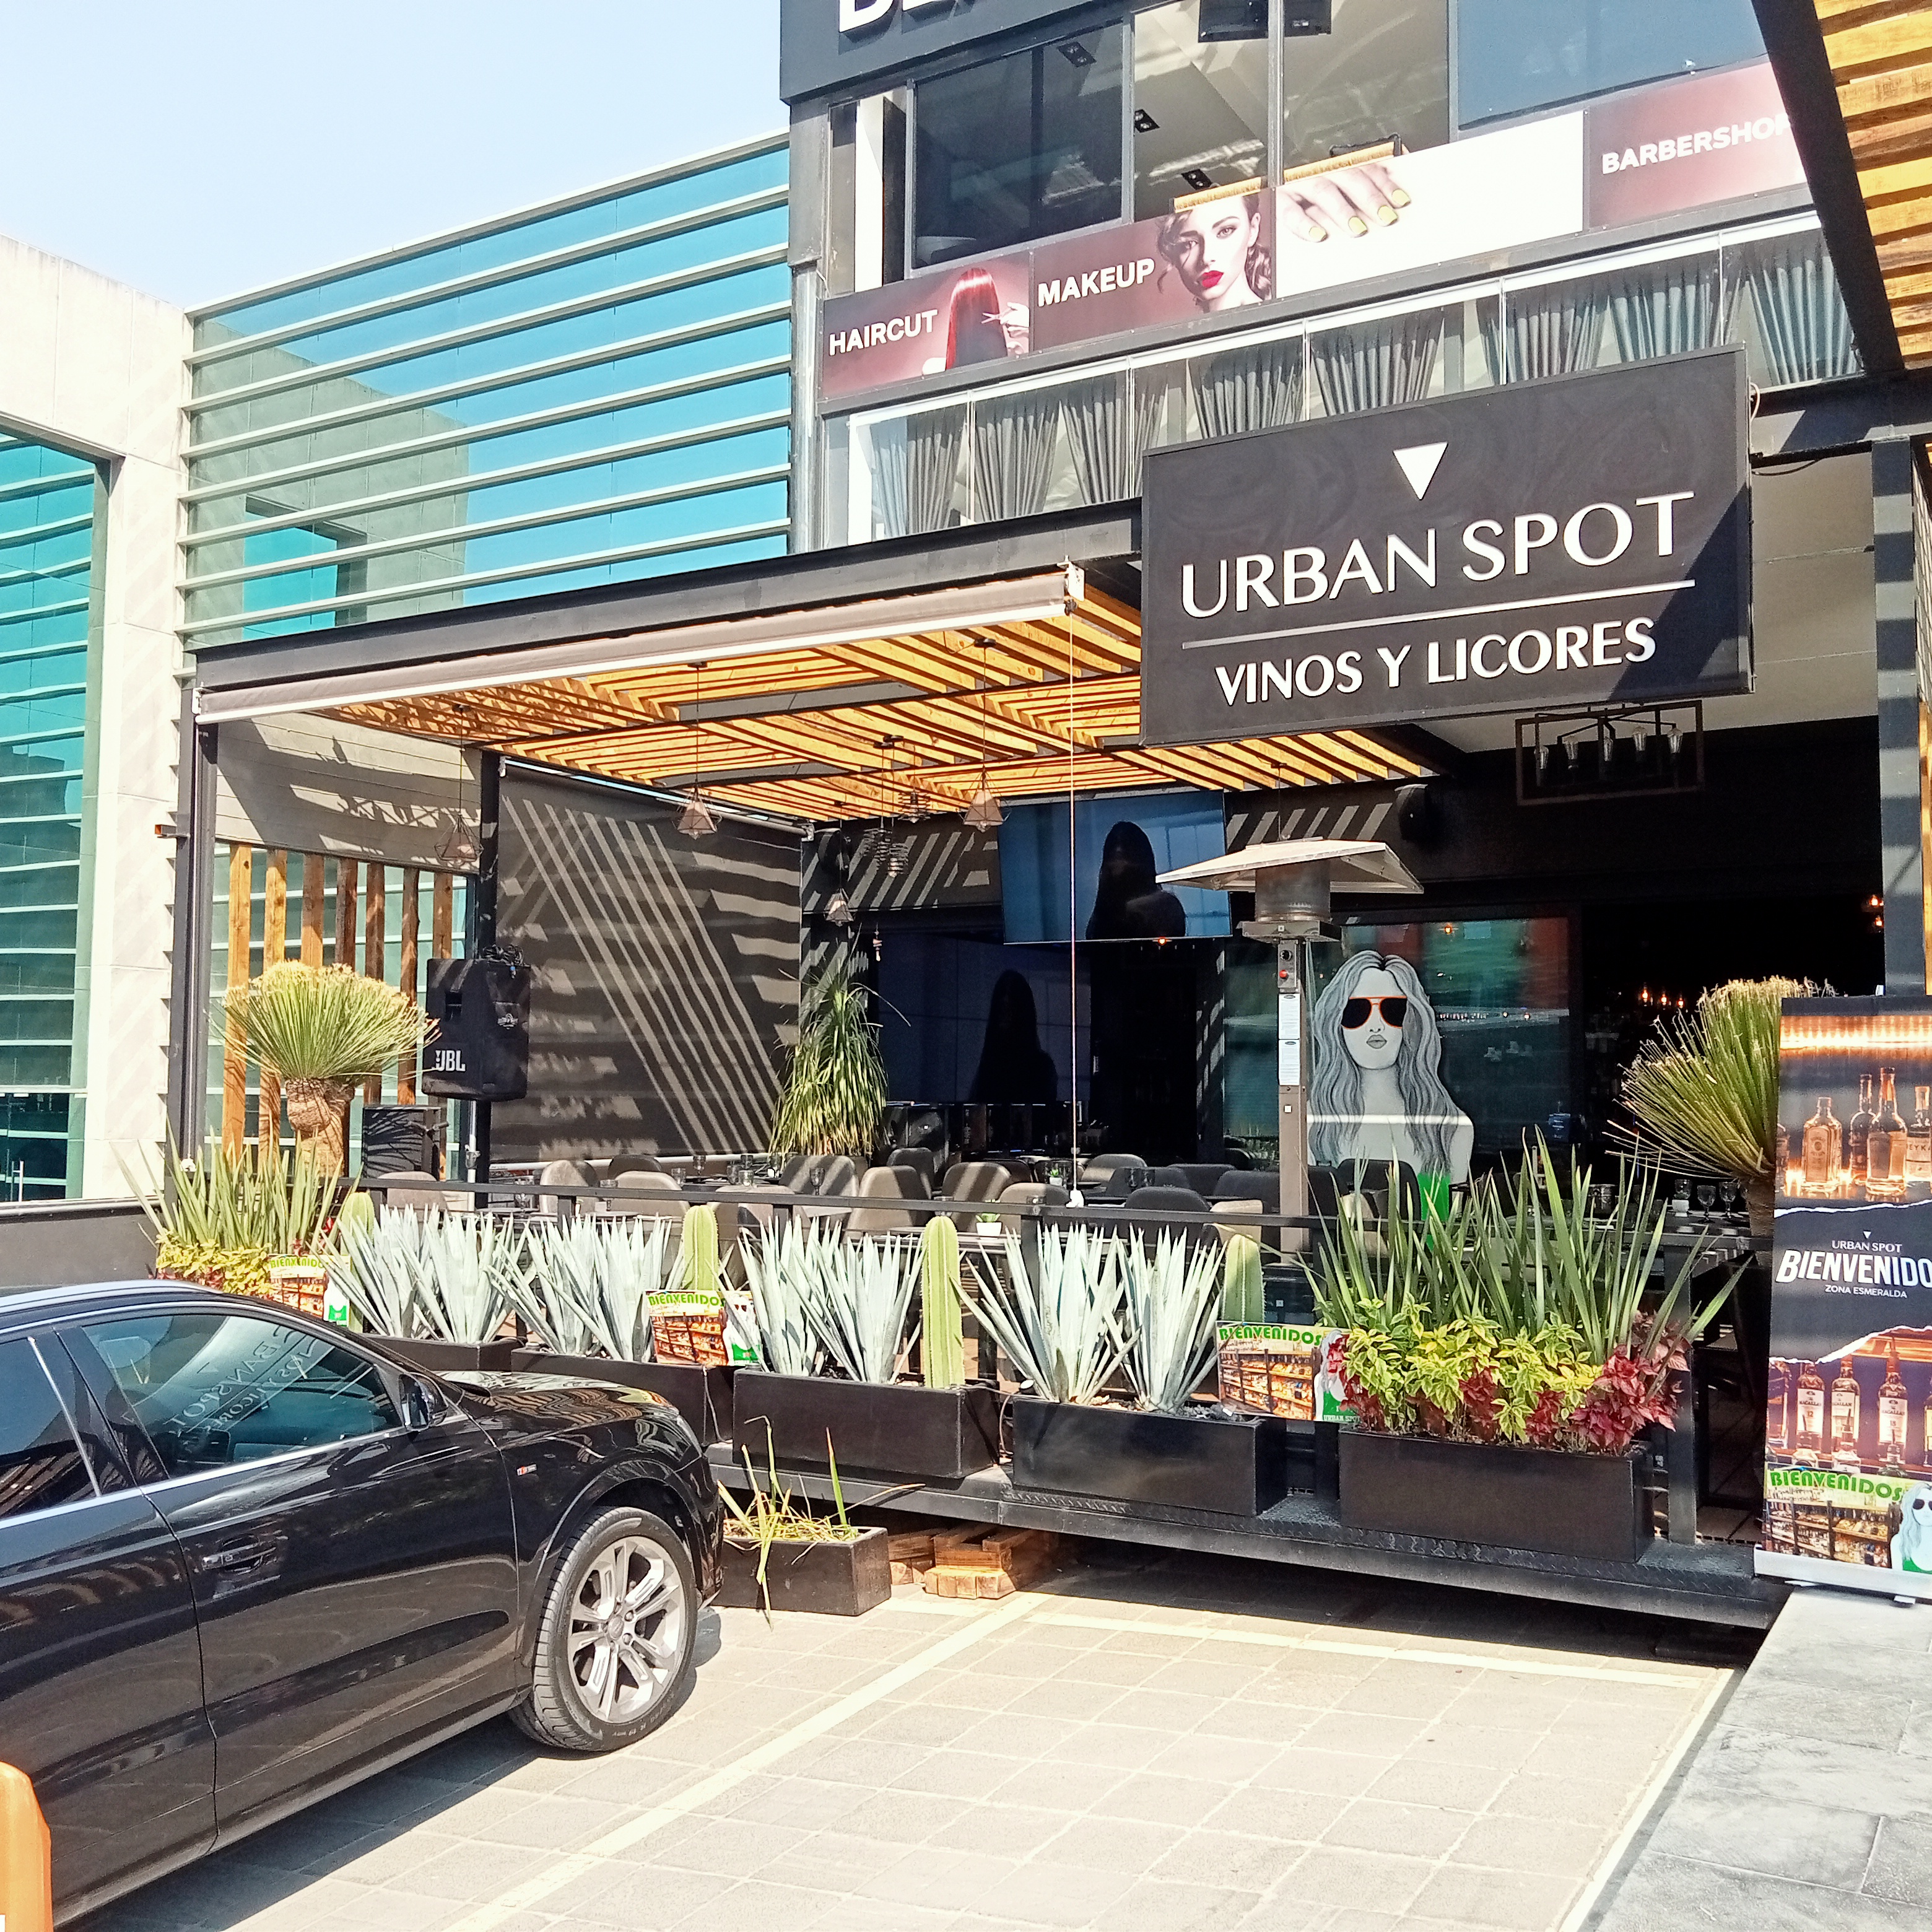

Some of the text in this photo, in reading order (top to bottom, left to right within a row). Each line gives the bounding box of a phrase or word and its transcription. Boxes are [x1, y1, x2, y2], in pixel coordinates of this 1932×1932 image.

[1037, 257, 1155, 307] MAKEUP
[829, 309, 939, 356] HAIRCUT
[1181, 492, 1695, 619] URBAN SPOT
[1215, 617, 1657, 706] VINOS Y LICORES
[435, 1050, 466, 1072] JBL
[1832, 1240, 1903, 1253] URBAN SPOT
[648, 1293, 726, 1307] BIENVENIDOS
[1825, 1284, 1908, 1299] ZONA ESMERALDA
[1219, 1326, 1322, 1346] BIENVENIDOS
[1770, 1471, 1903, 1502] BIENVENIDOS
